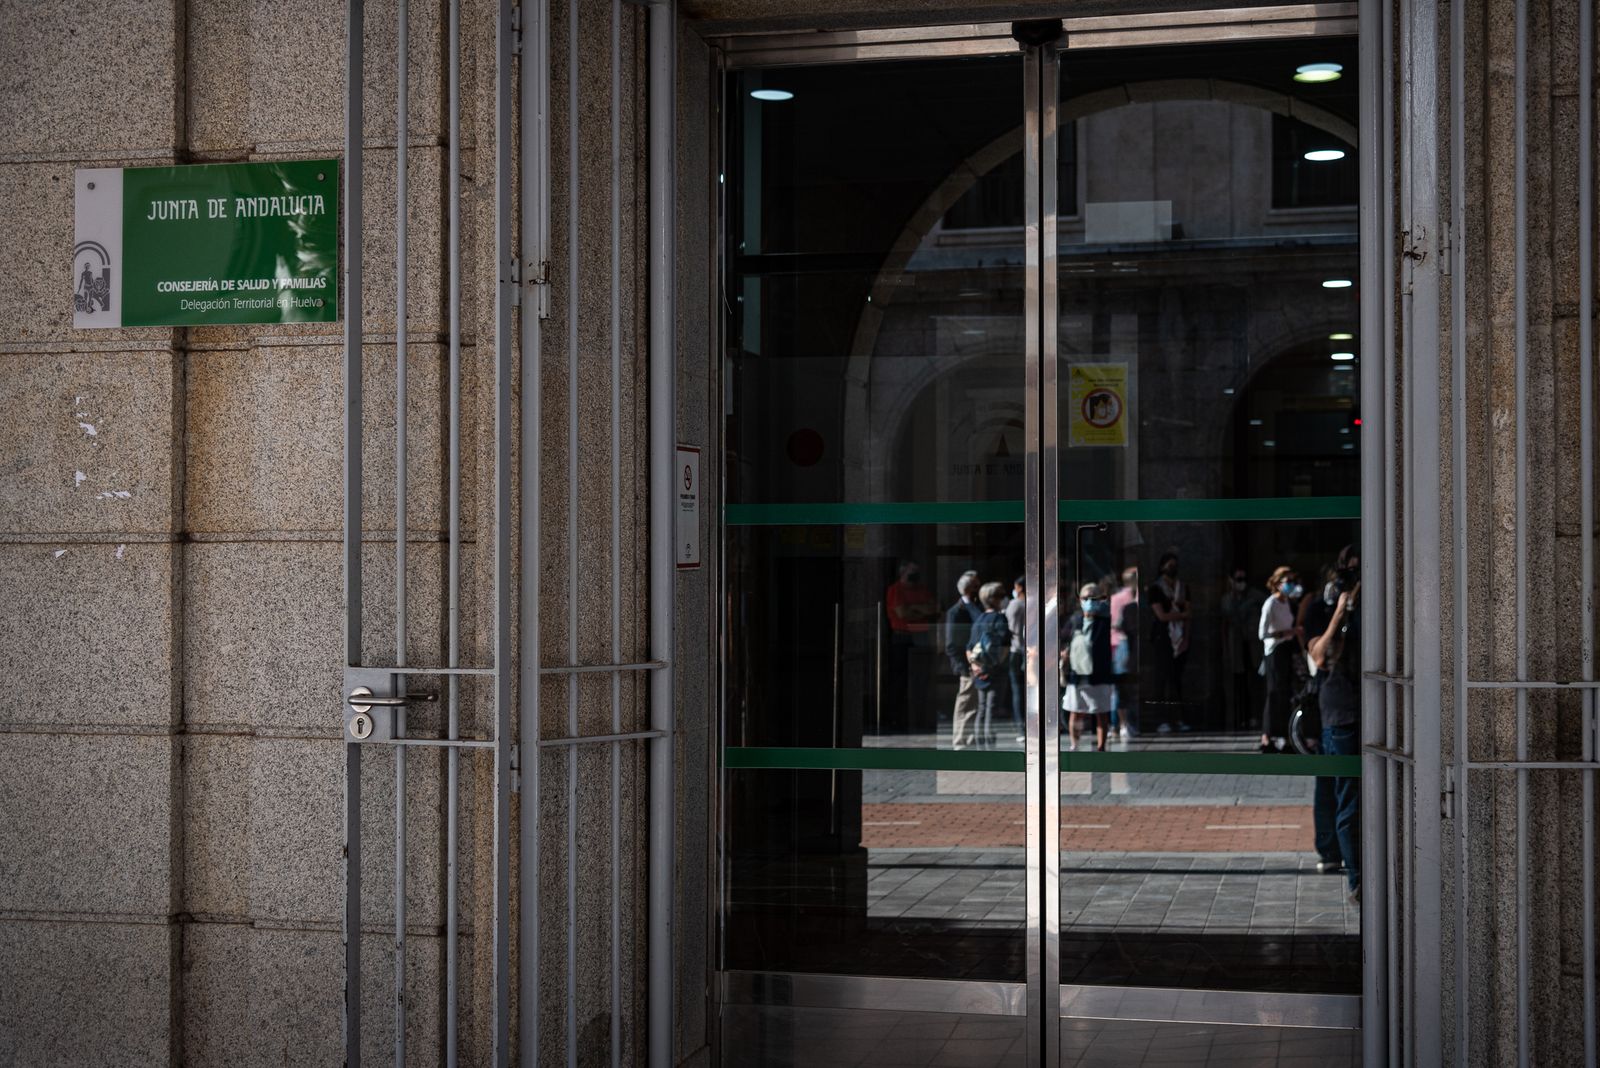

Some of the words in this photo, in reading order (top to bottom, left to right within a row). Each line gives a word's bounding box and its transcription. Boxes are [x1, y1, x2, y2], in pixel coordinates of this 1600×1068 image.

[147, 200, 199, 221] JUNTA
[207, 199, 227, 219] DE
[235, 195, 325, 218] ANDALUCIA
[157, 277, 219, 292] CONSEJERÍA
[221, 280, 235, 291] DE
[237, 279, 270, 290] SALUD
[272, 278, 279, 290] Y
[280, 277, 327, 289] FAMILIAS
[180, 298, 230, 312] Delegación
[232, 297, 274, 309] Territorial
[276, 299, 289, 308] en
